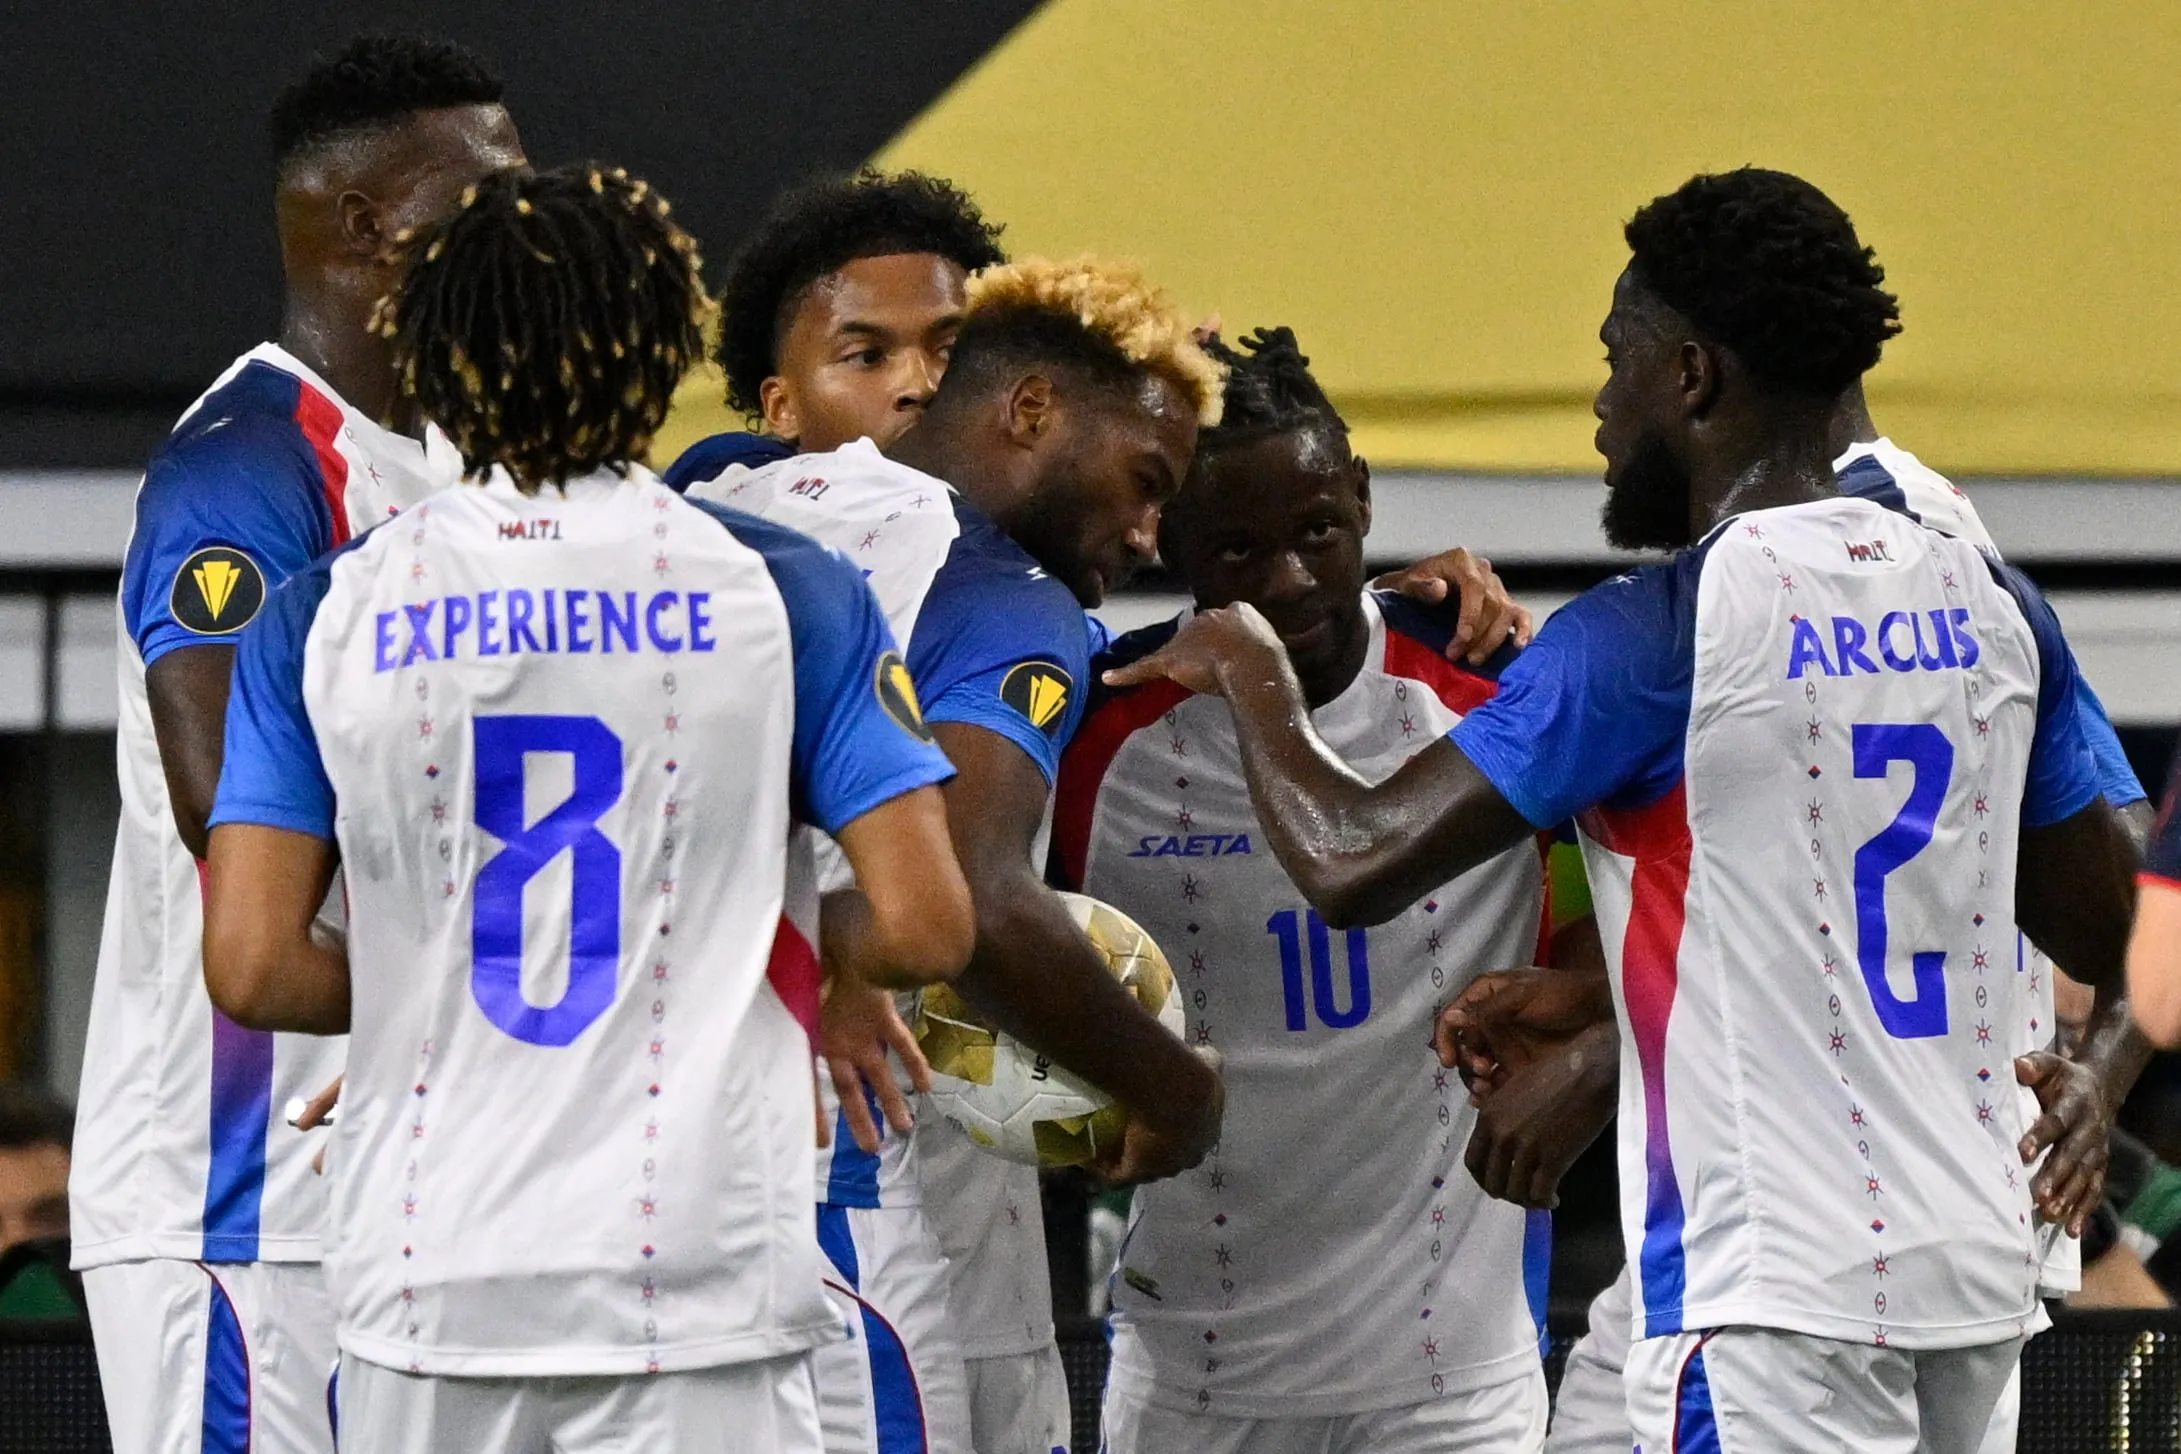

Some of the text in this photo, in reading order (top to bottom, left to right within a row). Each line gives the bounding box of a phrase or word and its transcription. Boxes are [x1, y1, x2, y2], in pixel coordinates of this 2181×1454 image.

[498, 518, 563, 540] HAITI
[375, 588, 716, 673] EXPERIENCE
[1787, 607, 1980, 680] ARCUS
[471, 714, 624, 1048] 8
[1127, 833, 1252, 858] SAETA
[1851, 723, 1954, 1039] 2
[1266, 908, 1372, 1032] 10
